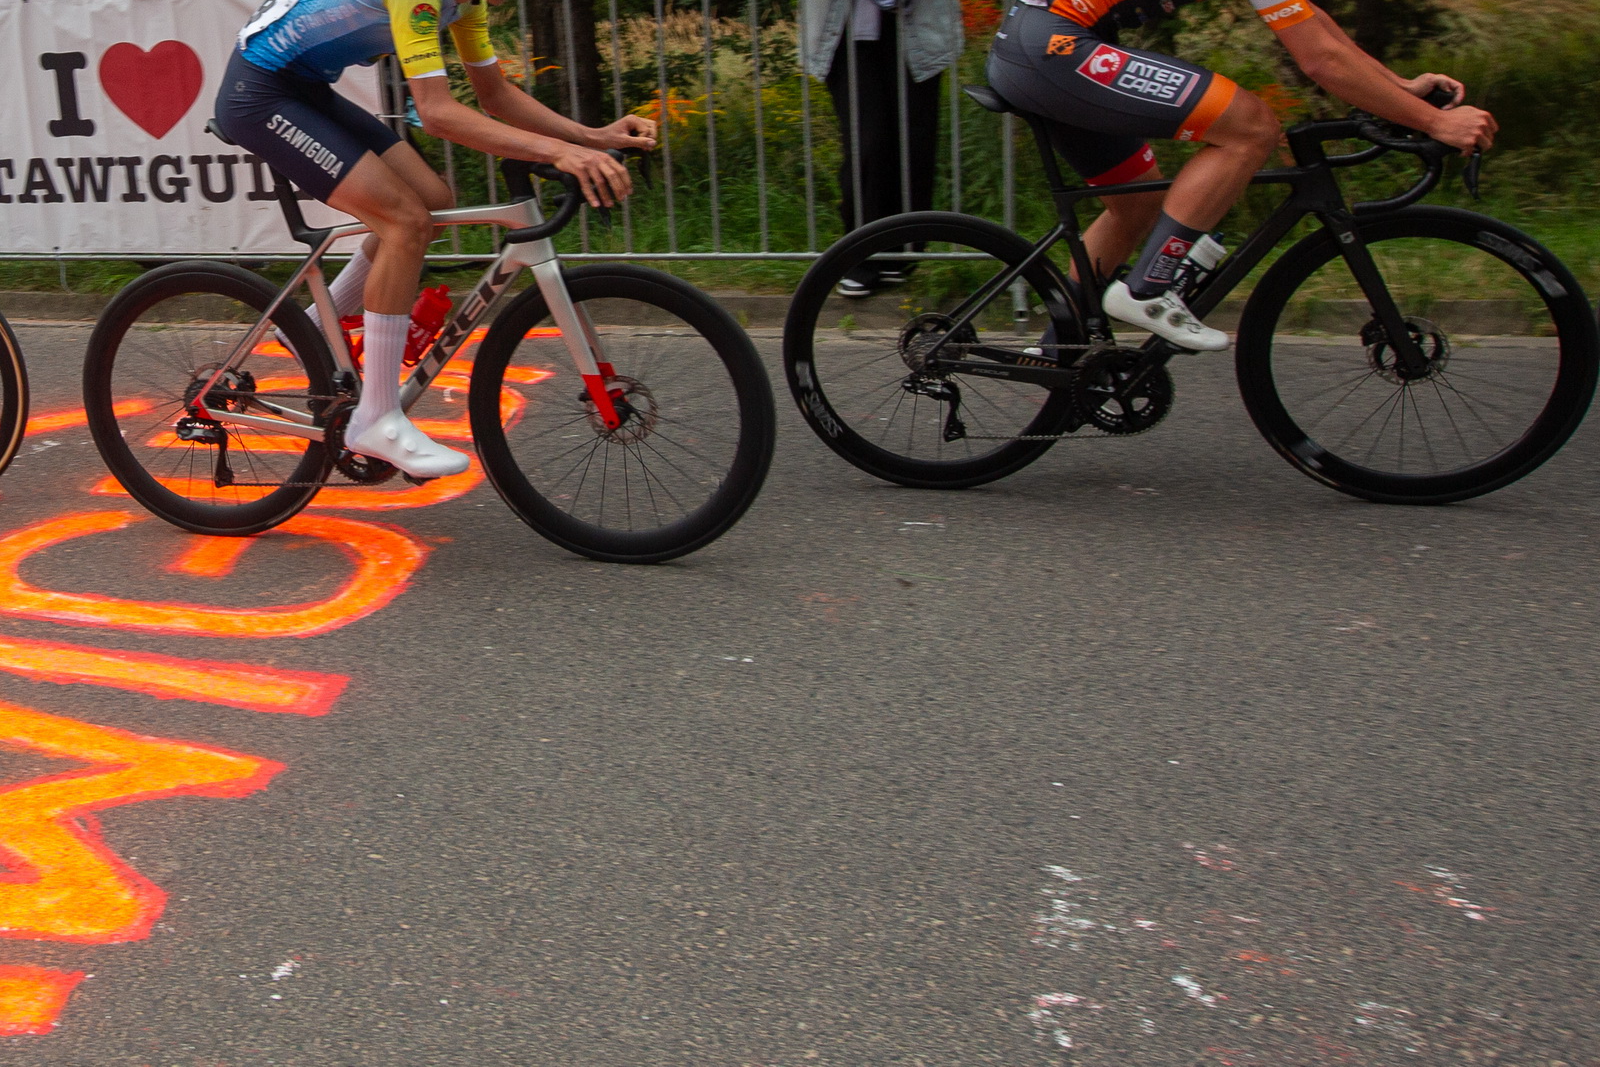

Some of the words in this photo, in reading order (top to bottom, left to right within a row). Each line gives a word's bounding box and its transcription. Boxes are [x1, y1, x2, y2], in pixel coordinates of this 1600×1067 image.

[41, 51, 96, 137] I
[1116, 73, 1179, 99] CARS
[1125, 60, 1187, 86] INTER
[266, 114, 344, 180] STAWIGUDA
[413, 260, 514, 387] TREK
